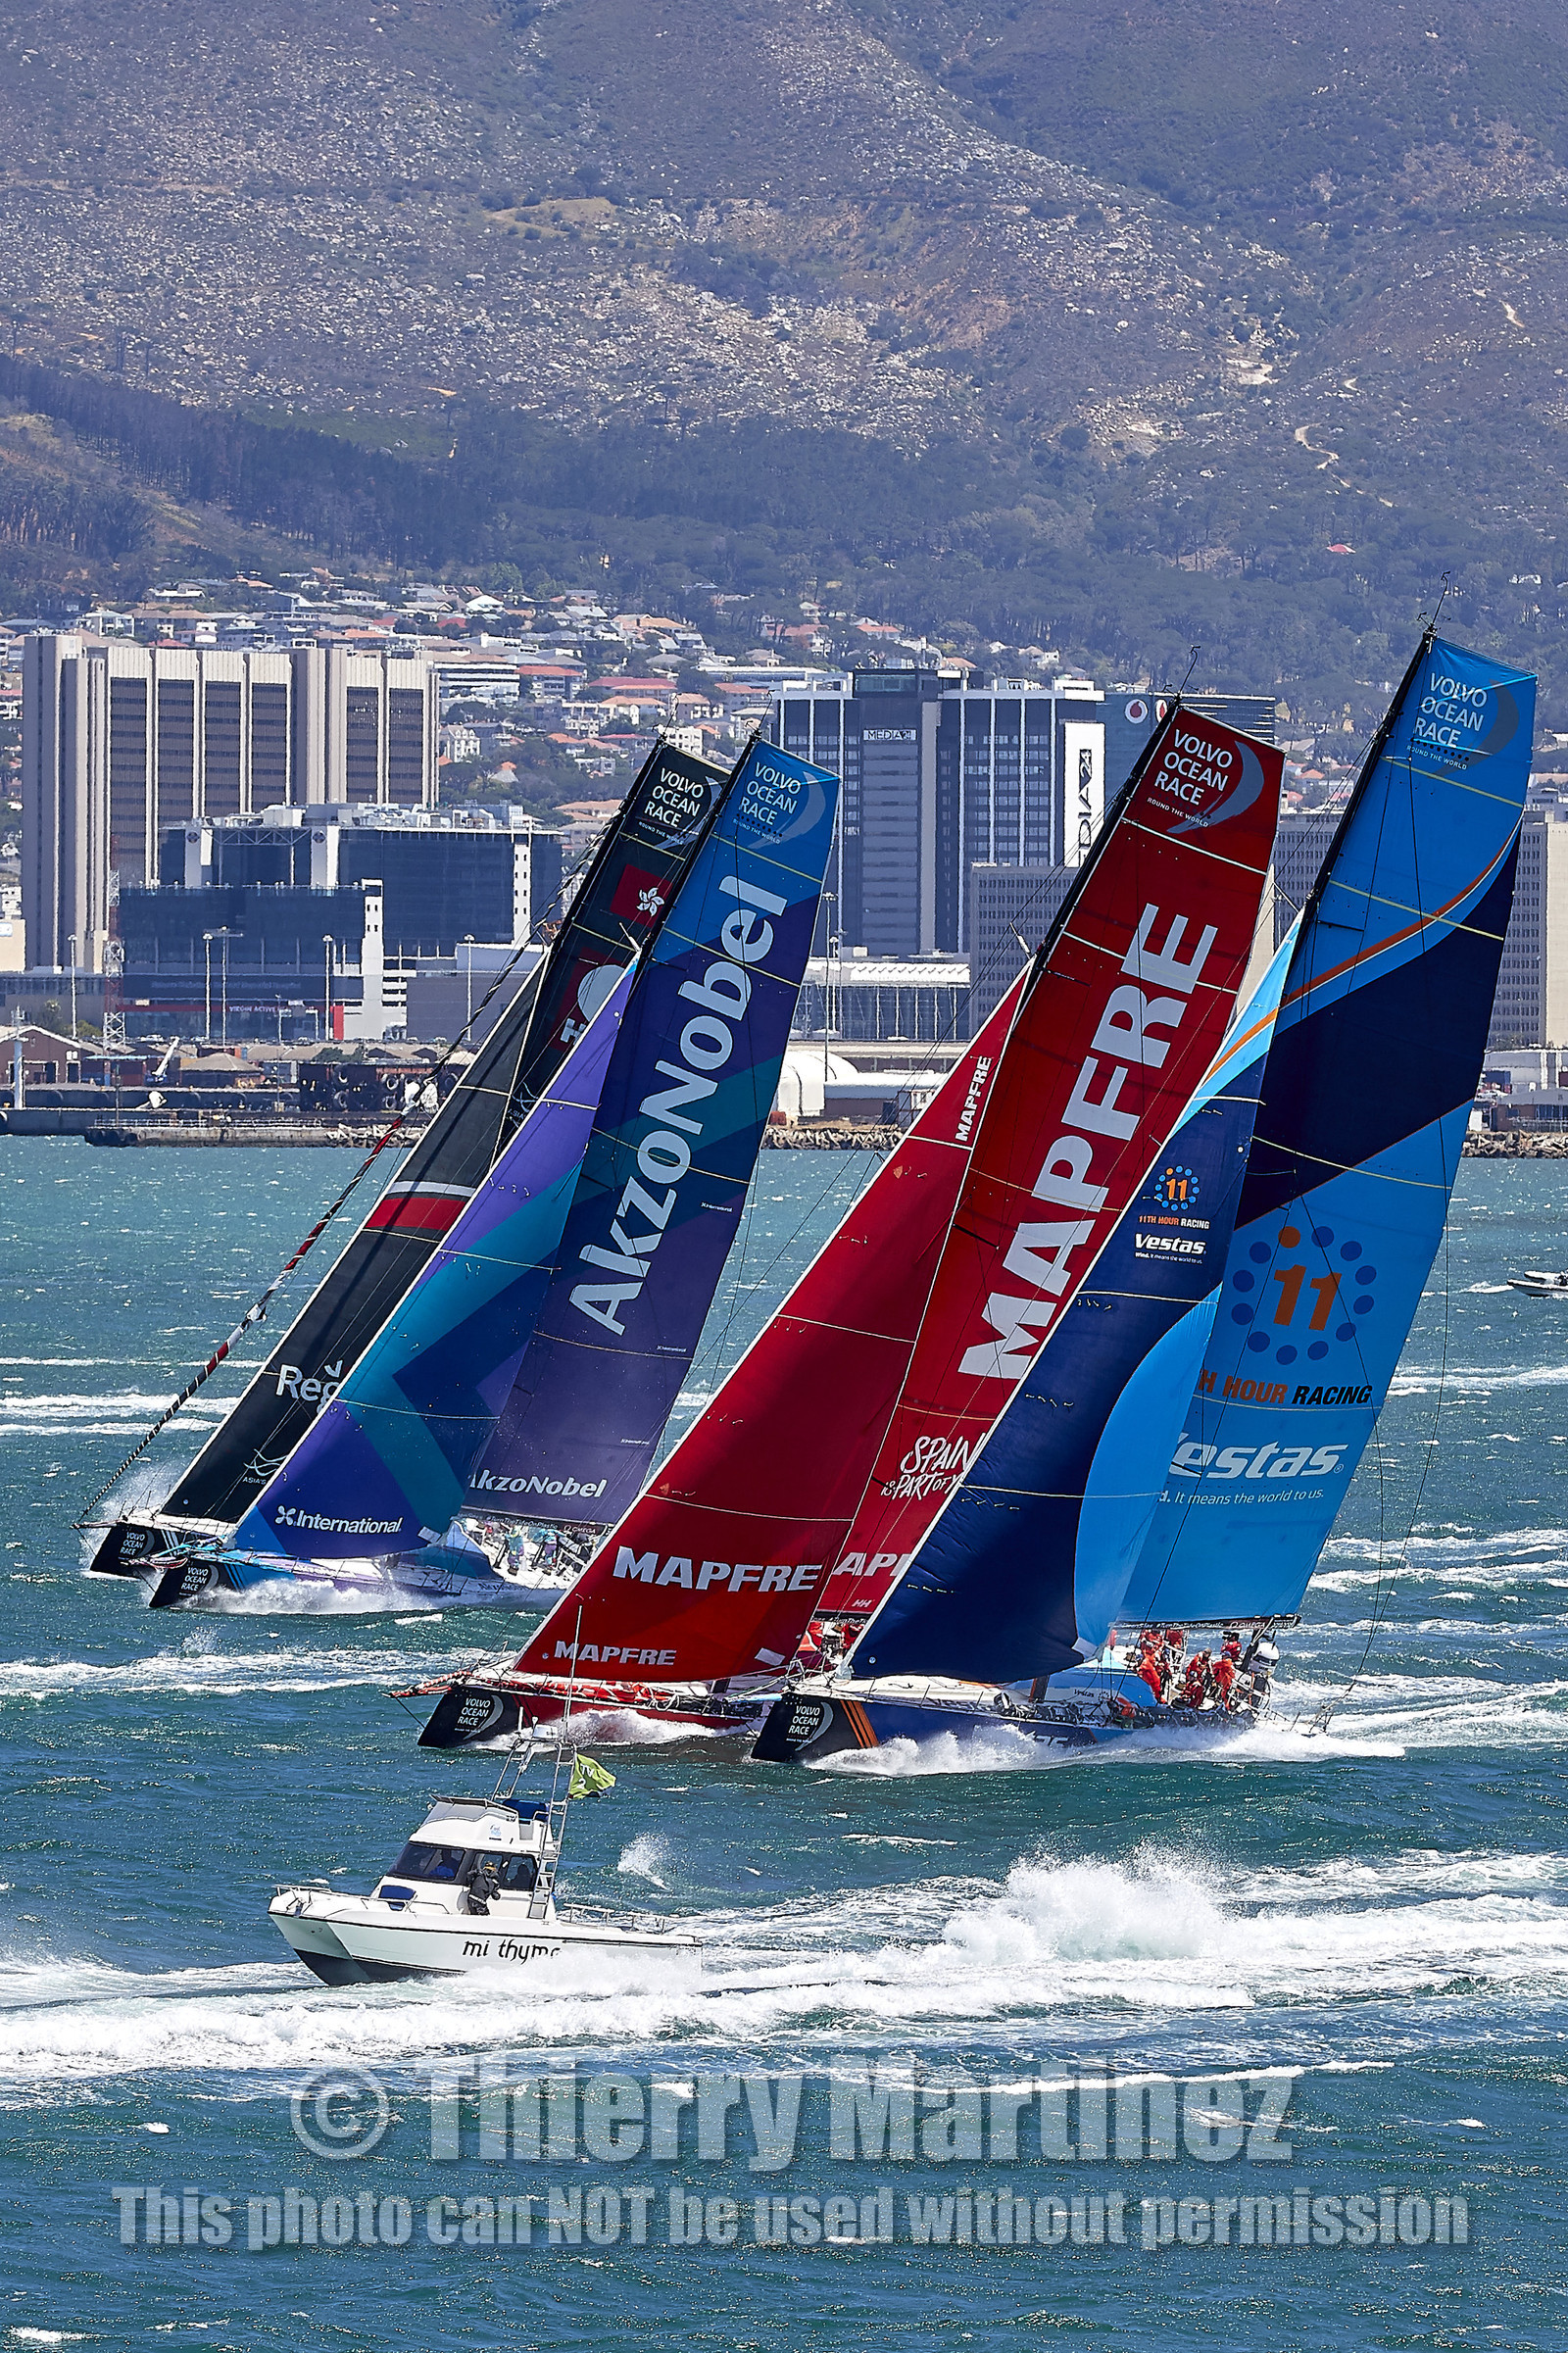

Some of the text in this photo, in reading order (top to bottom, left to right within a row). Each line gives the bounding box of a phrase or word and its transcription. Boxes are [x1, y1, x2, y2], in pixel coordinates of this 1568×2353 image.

[1430, 672, 1488, 708] VOLVO
[1421, 696, 1484, 732] OCEAN
[1414, 716, 1461, 748] RACE
[1174, 729, 1233, 768] VOLVO
[1406, 745, 1468, 770] ROUND THE WORLD
[661, 767, 704, 799] VOLVO
[755, 761, 801, 795] VOLVO
[1164, 752, 1229, 792] OCEAN
[652, 785, 701, 816] OCEAN
[747, 780, 797, 814] OCEAN
[1154, 770, 1205, 806] RACE
[644, 801, 682, 828] RACE
[739, 797, 777, 825] RACE
[1147, 797, 1209, 828] ROUND THE WORLD
[568, 875, 788, 1336] AkzoNobel
[956, 1055, 993, 1142] MAPFRE
[957, 903, 1218, 1380] MAPFRE
[1166, 1178, 1188, 1201] 11
[1139, 1215, 1210, 1229] 11TH HOUR RACING
[1135, 1233, 1206, 1254] Vestas
[1273, 1264, 1343, 1331] 11
[275, 1363, 340, 1414] Reg
[1222, 1375, 1289, 1404] HOUR
[1292, 1385, 1372, 1405] RACING
[900, 1432, 986, 1474] SPAIN
[892, 1472, 944, 1500] PART
[1175, 1492, 1186, 1503] It
[1187, 1493, 1231, 1505] means
[1234, 1491, 1255, 1504] the
[1257, 1489, 1292, 1503] world
[1295, 1491, 1306, 1500] to
[1308, 1489, 1324, 1498] us.
[296, 1509, 402, 1535] International
[123, 1540, 144, 1548] OCEAN
[184, 1575, 207, 1584] OCEAN
[187, 1567, 209, 1576] VOLVO
[613, 1546, 822, 1592] MAPFRE
[554, 1641, 676, 1666] MAPFRE
[462, 1707, 489, 1717] OCEAN
[466, 1697, 490, 1707] VOLVO
[796, 1705, 820, 1716] VOLVO
[458, 1716, 478, 1726] RACE
[788, 1725, 809, 1735] RACE
[792, 1715, 819, 1726] OCEAN
[580, 1763, 595, 1777] TV
[463, 1939, 490, 1957] mi
